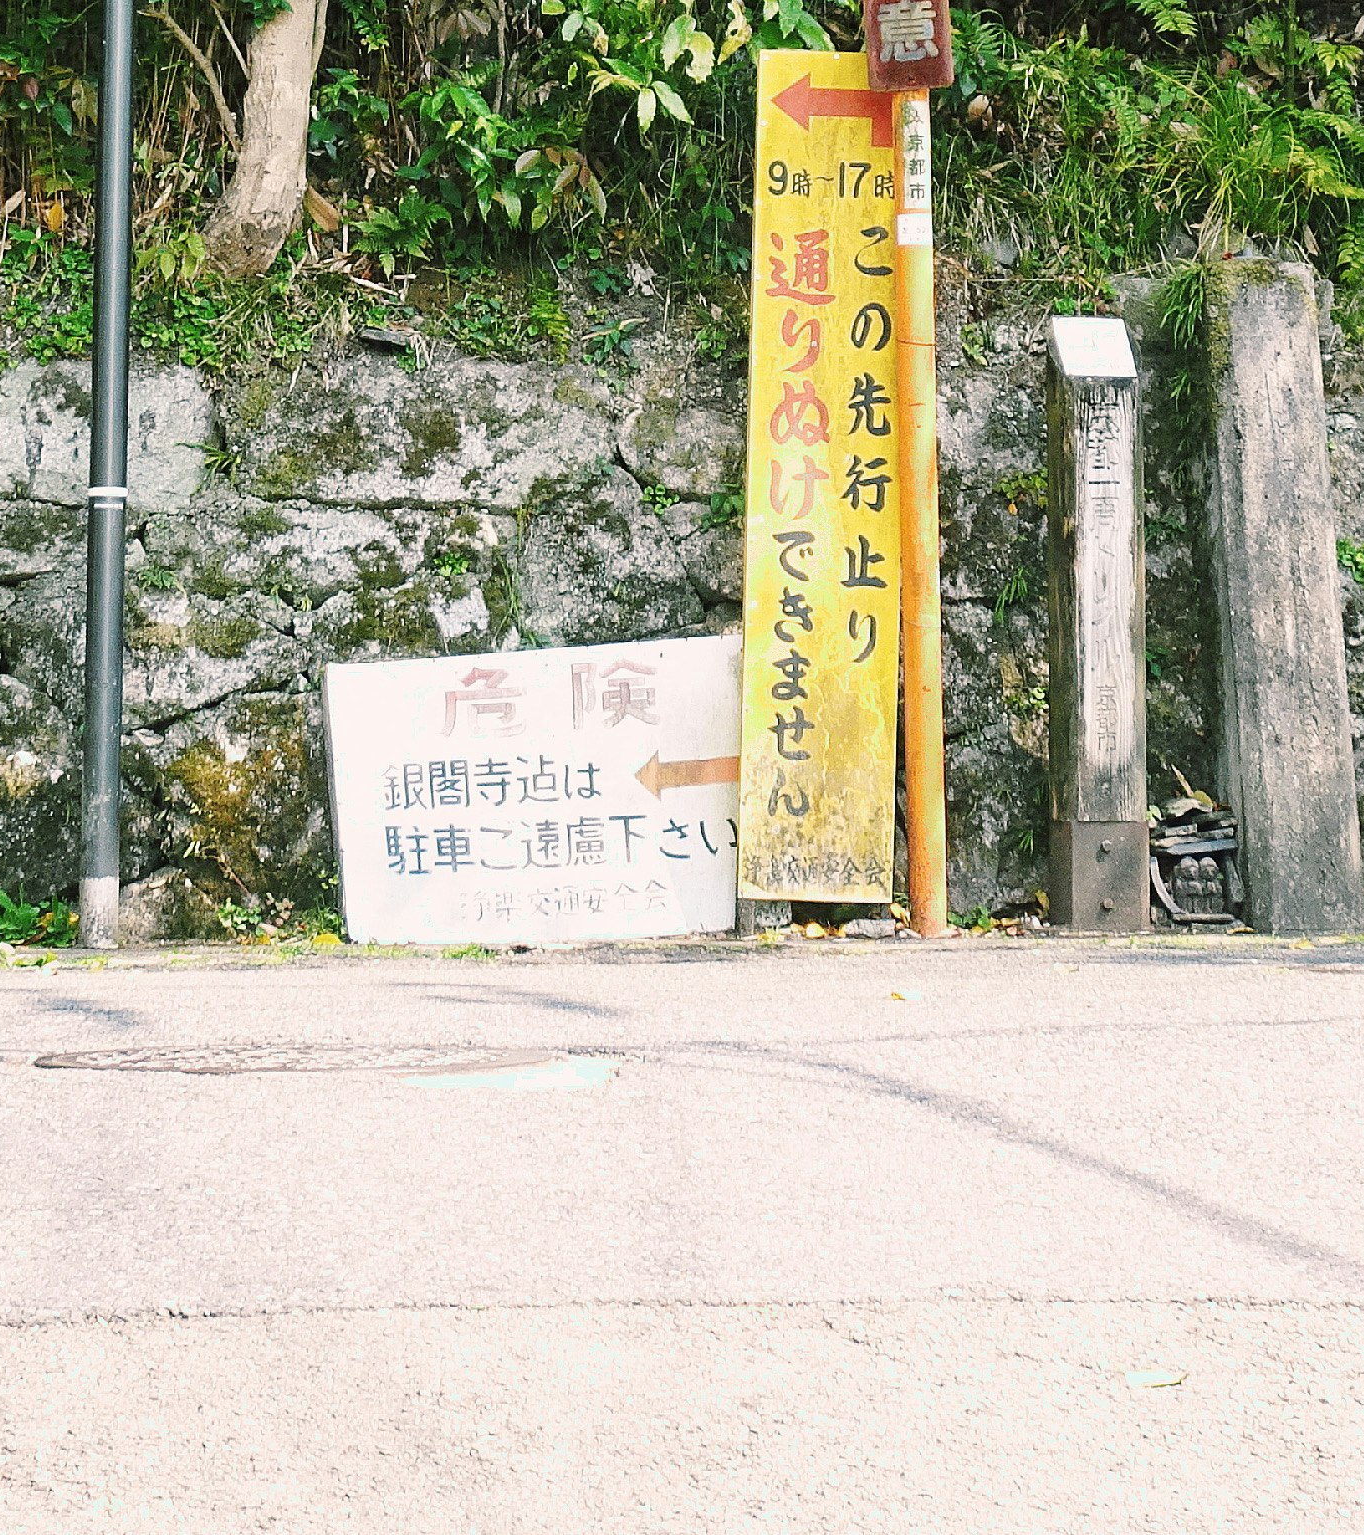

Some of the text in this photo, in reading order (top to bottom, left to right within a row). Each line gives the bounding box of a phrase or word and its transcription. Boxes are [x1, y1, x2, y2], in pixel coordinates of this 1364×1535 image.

[839, 226, 895, 665] この先行止り
[764, 227, 837, 818] 通りぬけできません
[441, 659, 660, 737] 危険
[1095, 683, 1118, 753] 京都市
[384, 814, 738, 876] 駐車ご遠慮下さい
